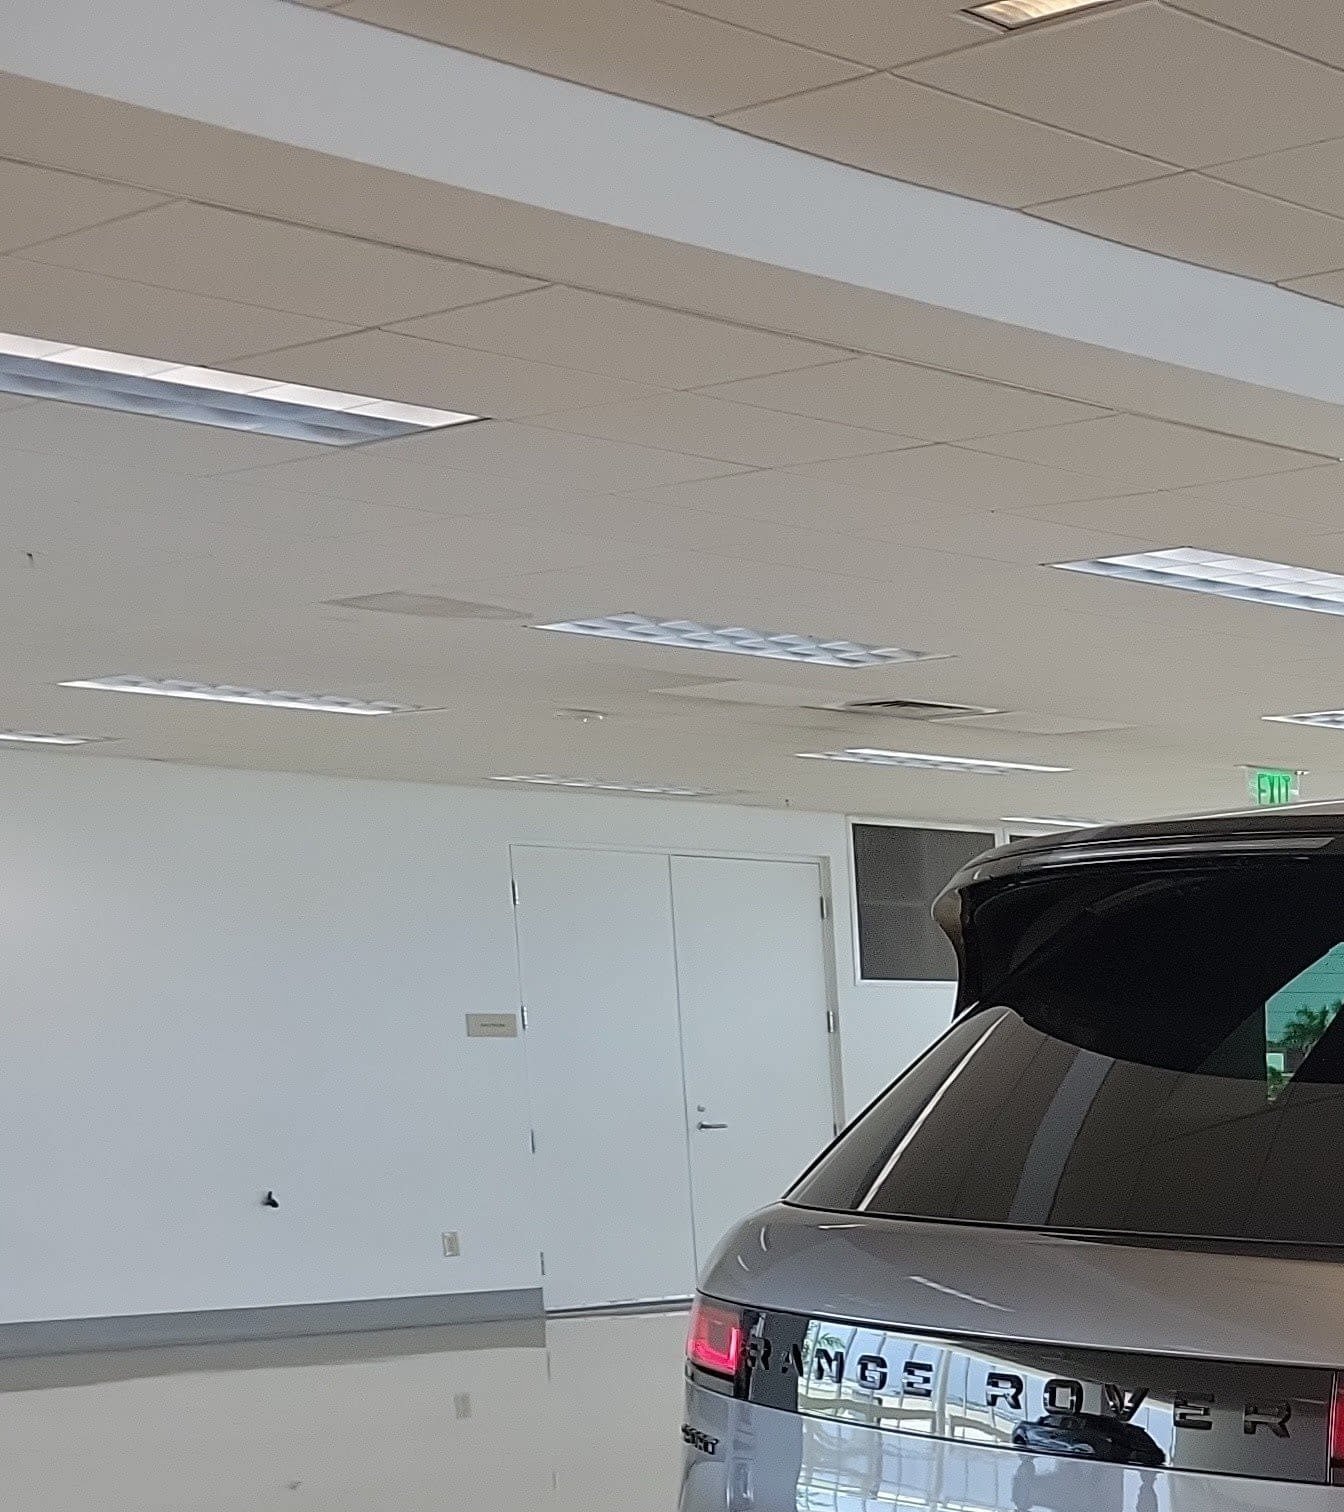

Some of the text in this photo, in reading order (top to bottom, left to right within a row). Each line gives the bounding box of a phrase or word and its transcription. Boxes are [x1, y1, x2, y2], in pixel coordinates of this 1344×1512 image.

[1257, 773, 1290, 804] EXIT
[742, 1336, 1293, 1439] RANGE ROVER
